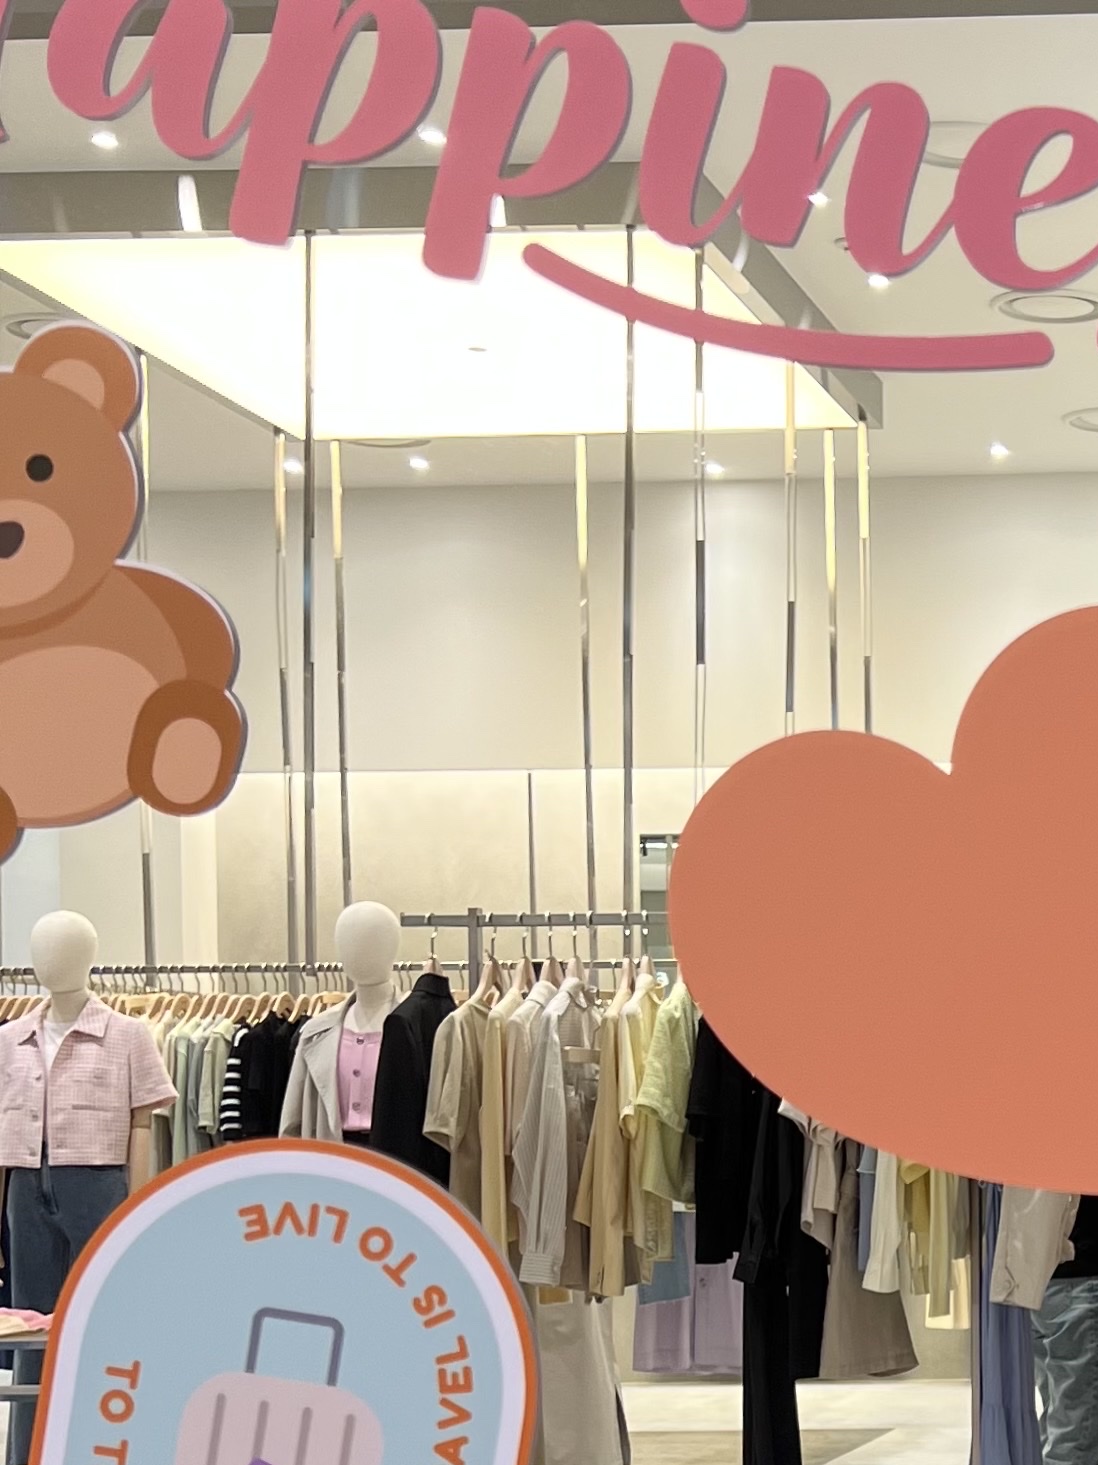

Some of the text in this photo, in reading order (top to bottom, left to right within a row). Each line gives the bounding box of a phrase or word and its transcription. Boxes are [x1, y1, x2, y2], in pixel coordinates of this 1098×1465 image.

[238, 1201, 350, 1244] LIVE
[358, 1226, 417, 1288] TO
[412, 1285, 456, 1329] IS
[99, 1359, 141, 1424] TO
